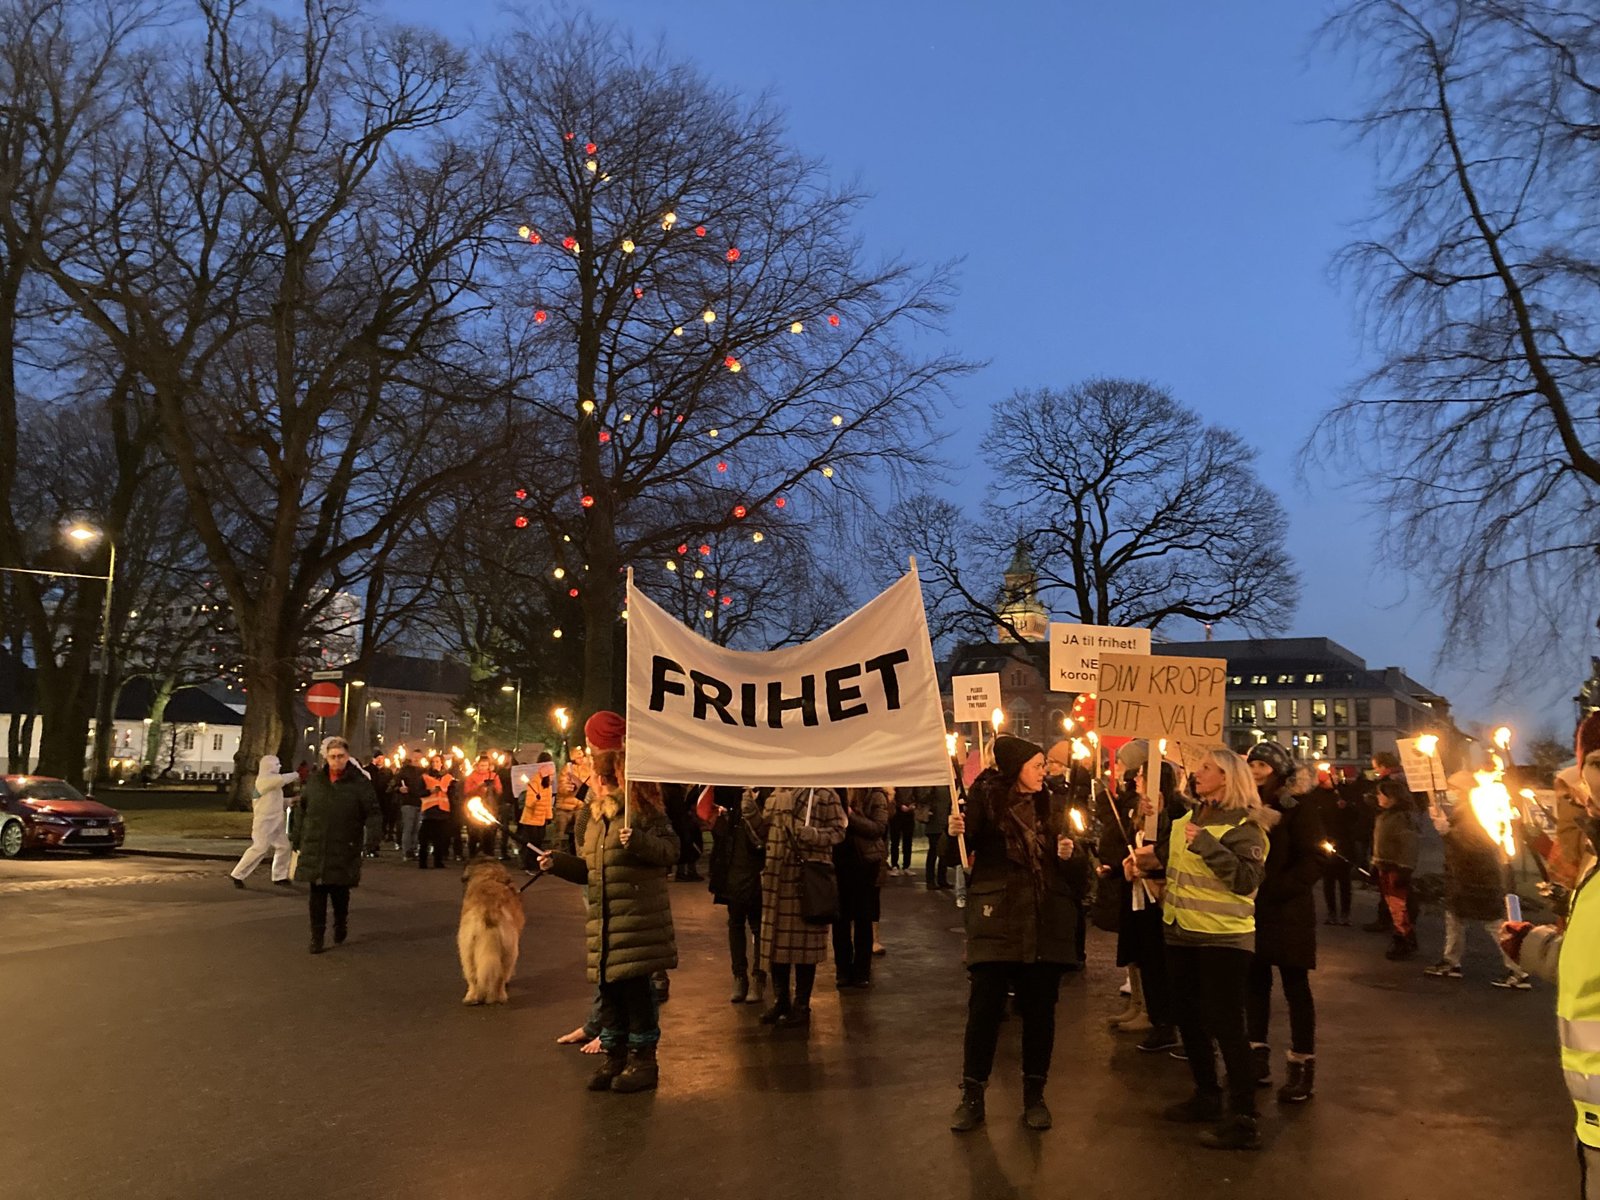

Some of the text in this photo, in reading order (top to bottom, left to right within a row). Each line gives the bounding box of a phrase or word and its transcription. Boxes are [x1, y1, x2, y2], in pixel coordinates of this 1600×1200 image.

[1062, 634, 1137, 650] JA til frihet!
[1060, 668, 1097, 681] koron
[1081, 658, 1099, 669] NE
[648, 648, 910, 729] FRIHET
[1099, 663, 1227, 697] DIN KROPP
[1098, 698, 1222, 738] DITT VALG
